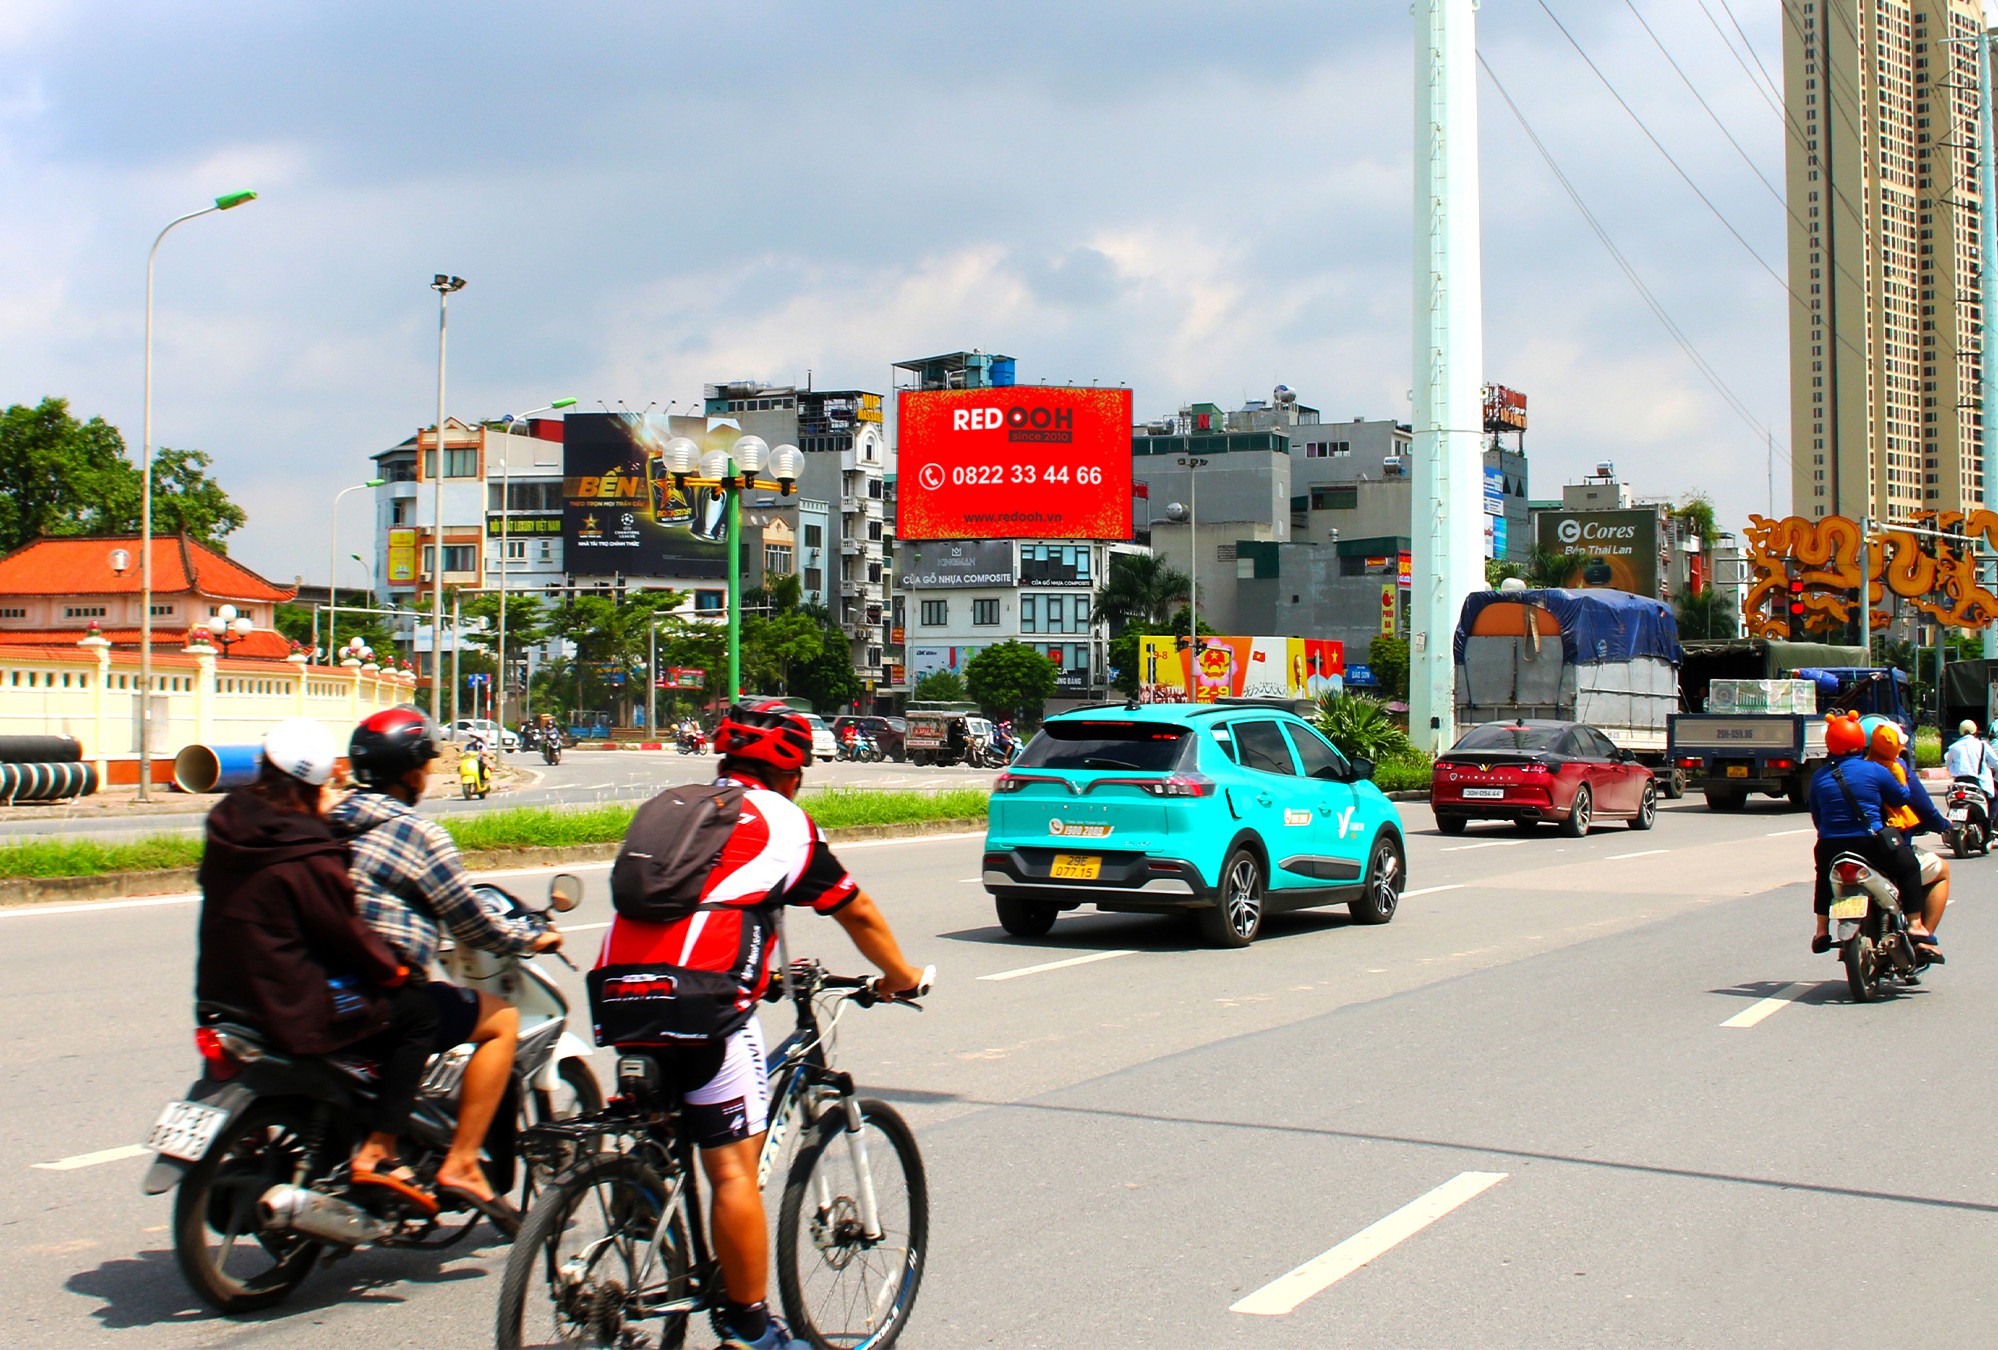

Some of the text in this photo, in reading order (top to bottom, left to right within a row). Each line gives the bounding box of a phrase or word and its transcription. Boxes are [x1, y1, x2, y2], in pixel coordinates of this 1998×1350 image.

[862, 393, 881, 410] VIP
[1012, 431, 1069, 442] since 2010
[952, 464, 1102, 485] 0822 33 44 66
[656, 508, 692, 518] ROCKSTAR
[964, 511, 1062, 523] www.redooh.vn
[1583, 522, 1635, 540] Cores
[1613, 546, 1632, 555] Lan
[937, 557, 976, 567] KINGMAN
[922, 572, 937, 584] GỖ
[938, 575, 963, 585] NHỰA
[963, 573, 1011, 583] COMPOSITE
[1198, 685, 1230, 698] 2-9
[1064, 825, 1083, 835] 1900
[1066, 855, 1088, 867] 29E
[1055, 866, 1094, 878] 077.15
